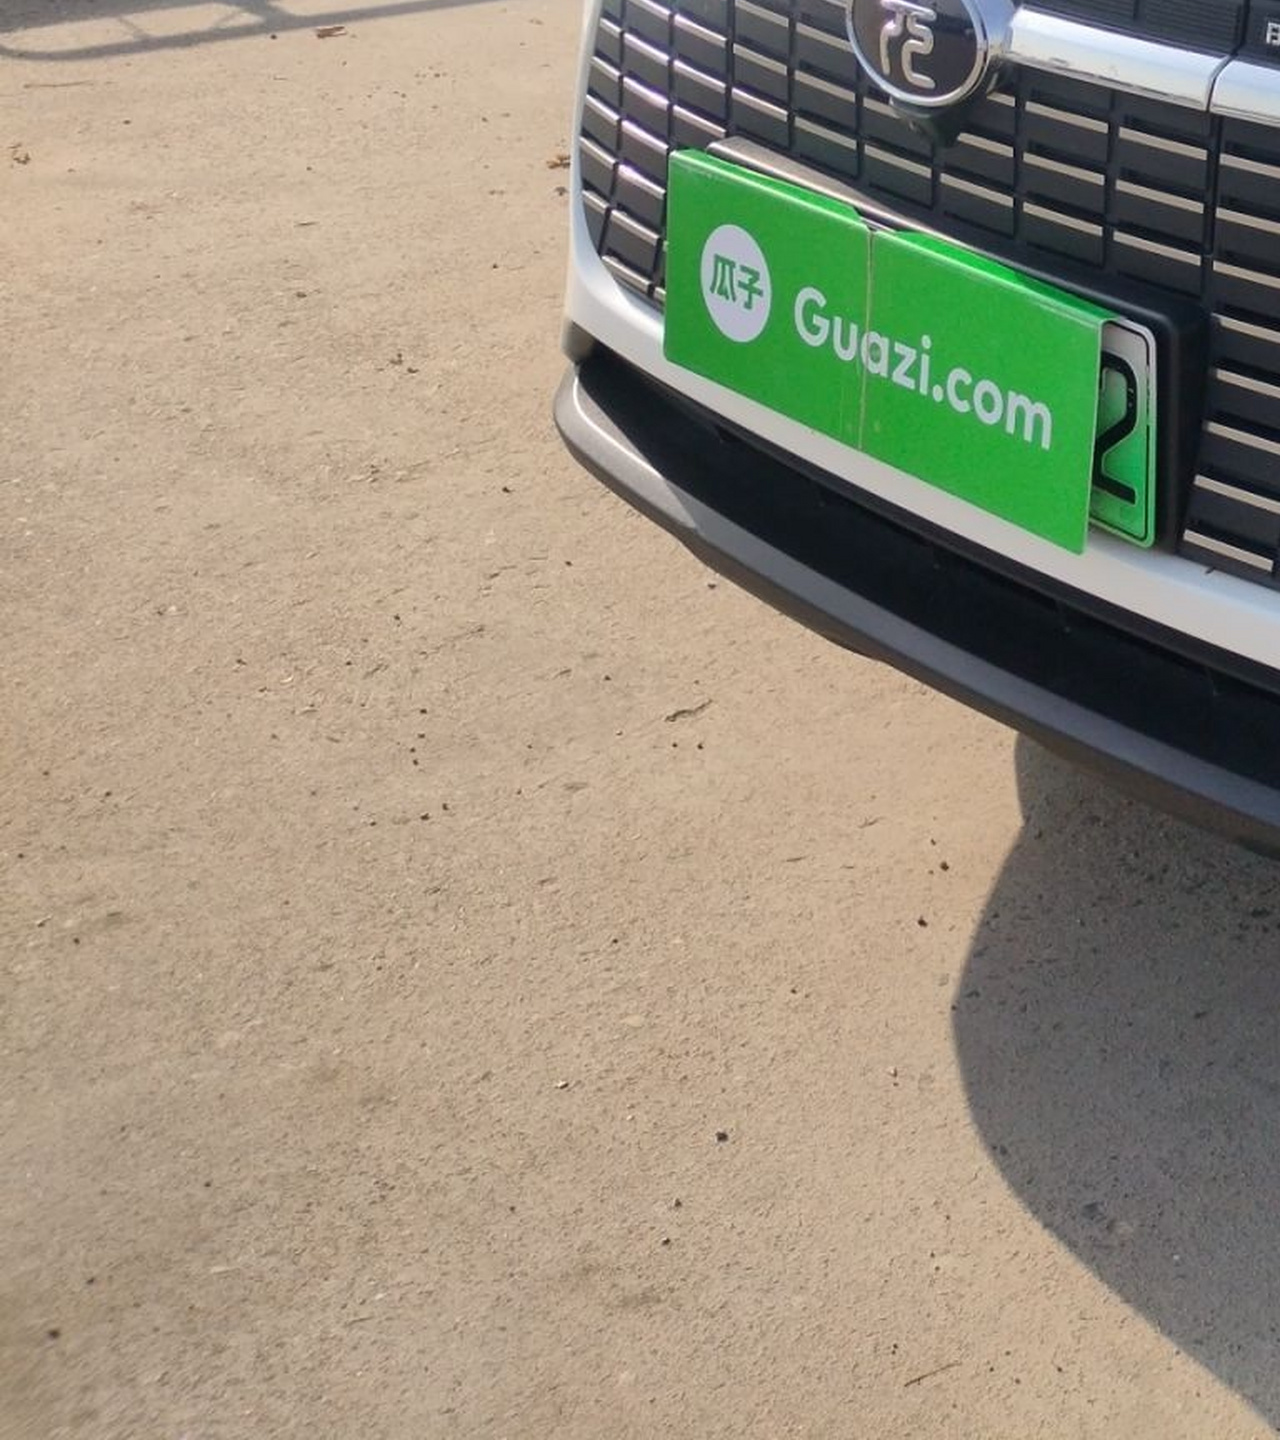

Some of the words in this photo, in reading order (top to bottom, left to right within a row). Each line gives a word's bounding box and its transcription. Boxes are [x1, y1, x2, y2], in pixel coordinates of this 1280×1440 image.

[708, 253, 765, 311] 瓜子
[793, 285, 1053, 452] Guazi.com
[1095, 349, 1138, 506] 2
